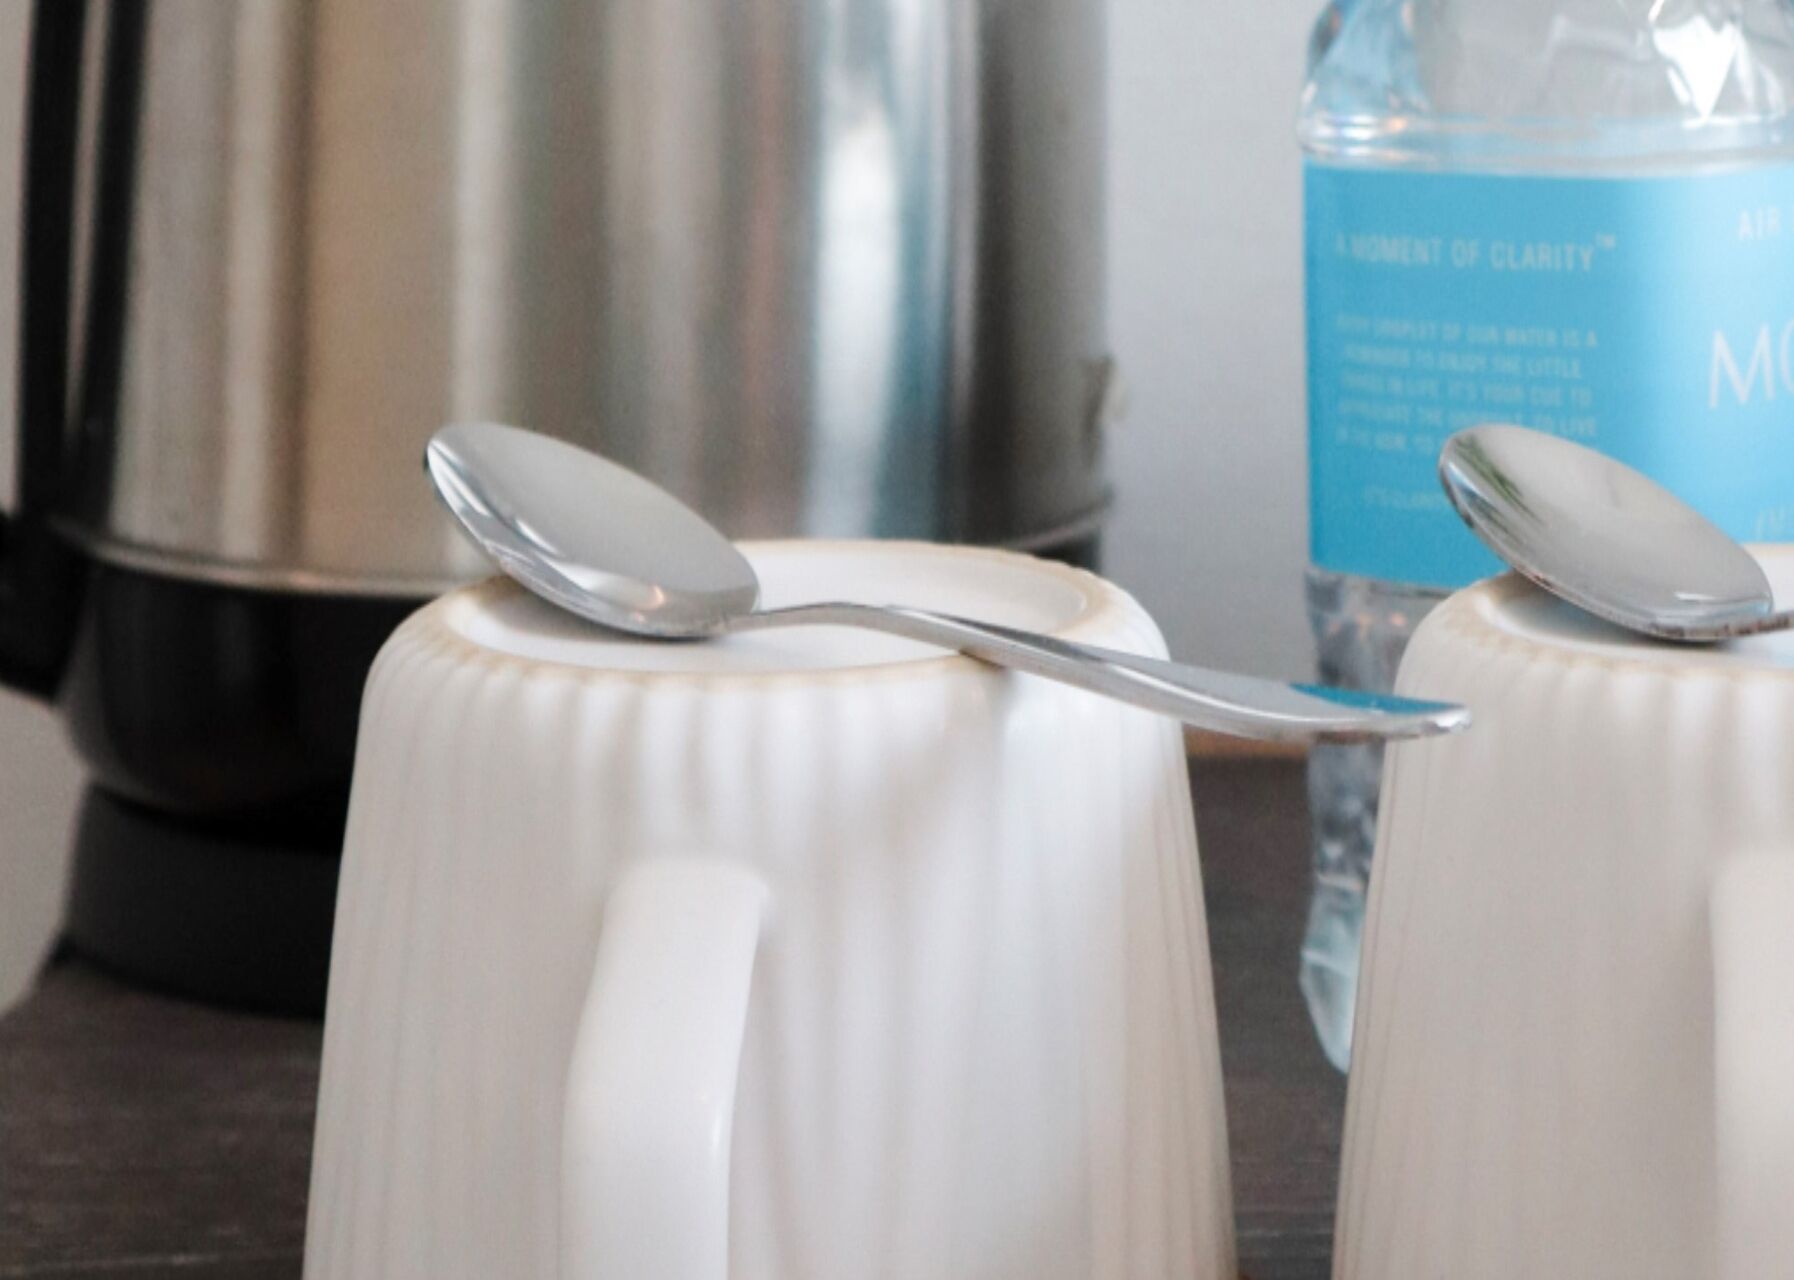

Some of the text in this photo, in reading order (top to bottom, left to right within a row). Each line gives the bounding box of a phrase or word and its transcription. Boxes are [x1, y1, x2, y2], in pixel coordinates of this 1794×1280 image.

[1738, 208, 1782, 242] AIR
[1350, 233, 1443, 267] MOMENT
[1450, 238, 1480, 268] OF
